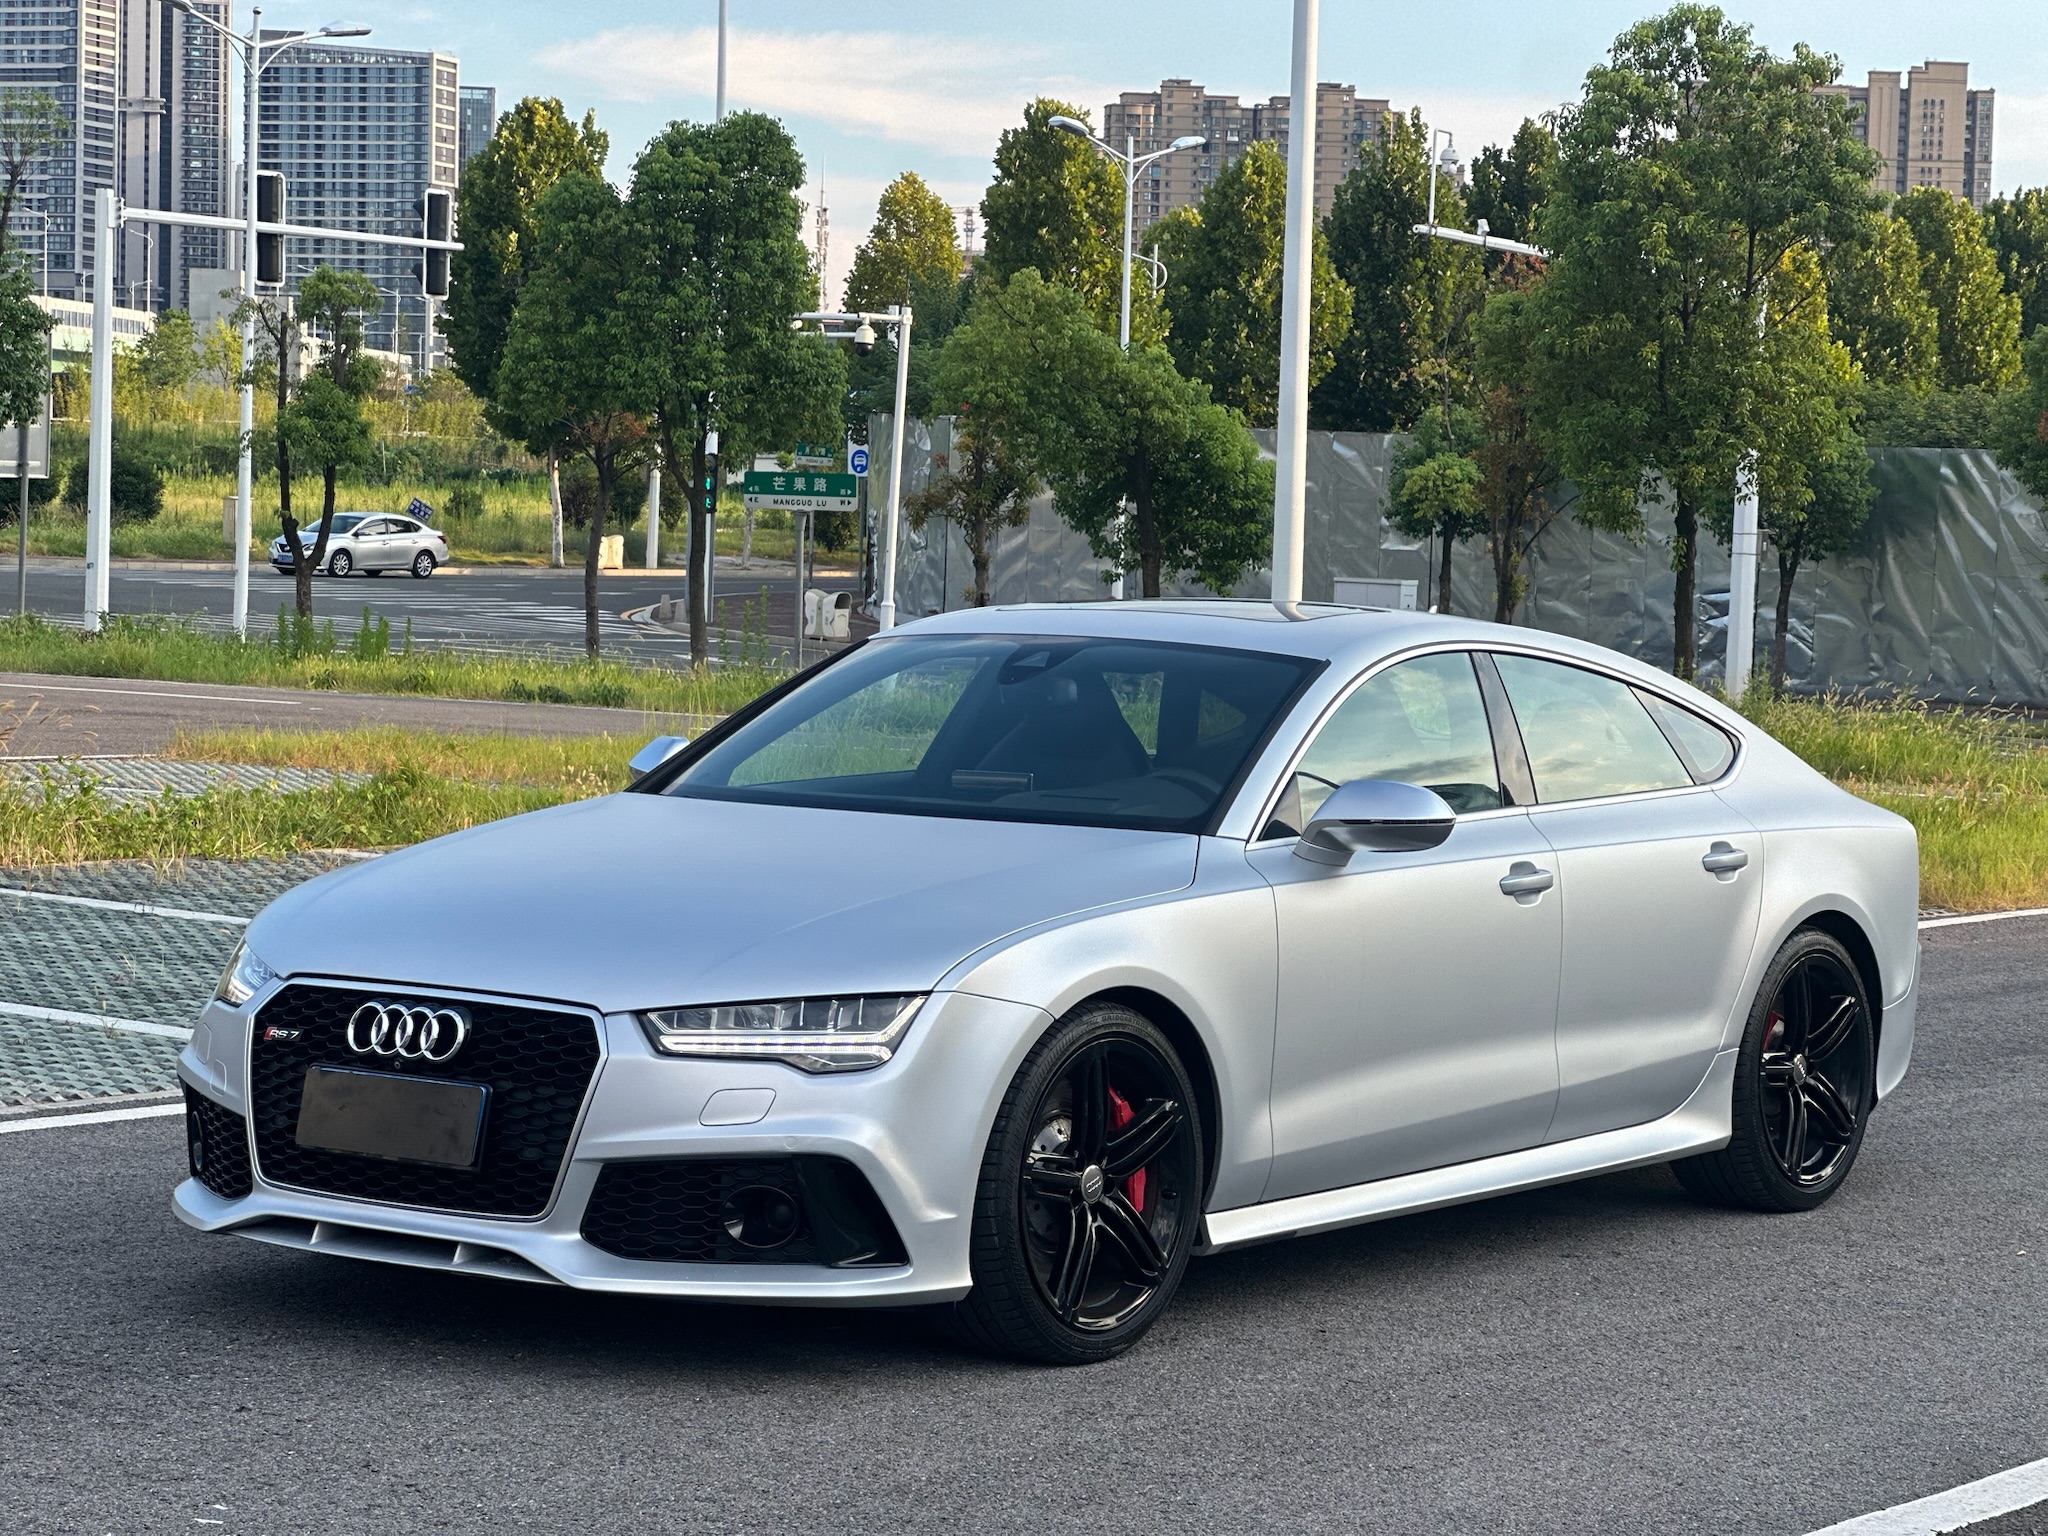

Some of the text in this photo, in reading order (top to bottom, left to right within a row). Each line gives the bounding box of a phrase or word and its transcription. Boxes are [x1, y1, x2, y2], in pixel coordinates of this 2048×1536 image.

[772, 476, 828, 492] 芒果路
[773, 499, 812, 507] MANGGUO
